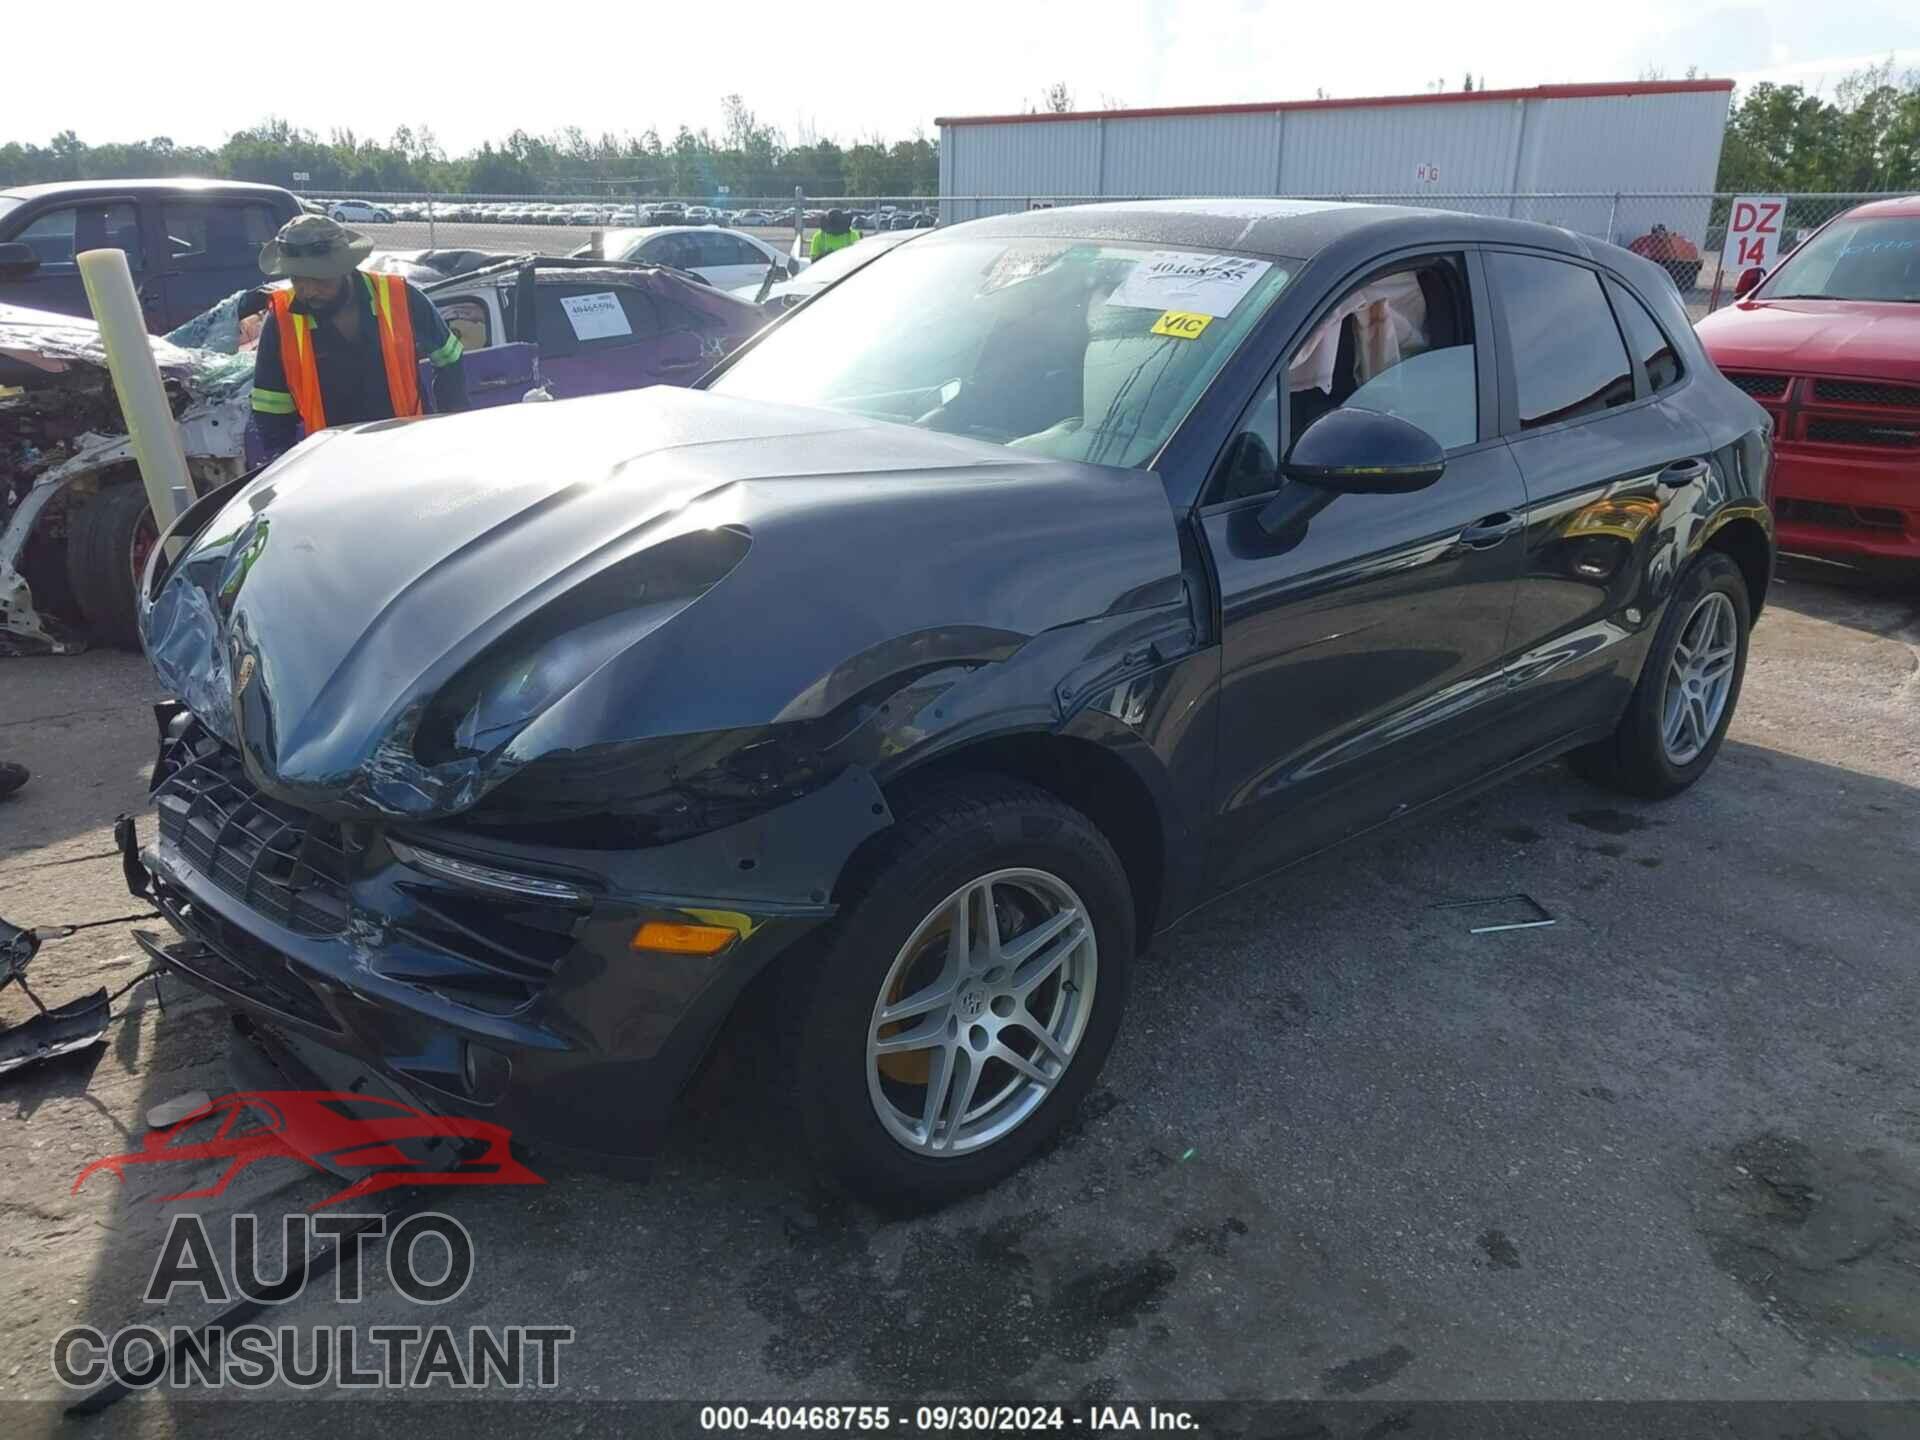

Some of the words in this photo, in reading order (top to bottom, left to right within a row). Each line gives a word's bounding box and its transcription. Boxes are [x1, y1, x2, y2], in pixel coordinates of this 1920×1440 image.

[1733, 202, 1782, 233] DZ
[1737, 236, 1766, 266] 14
[1163, 315, 1204, 332] VIC
